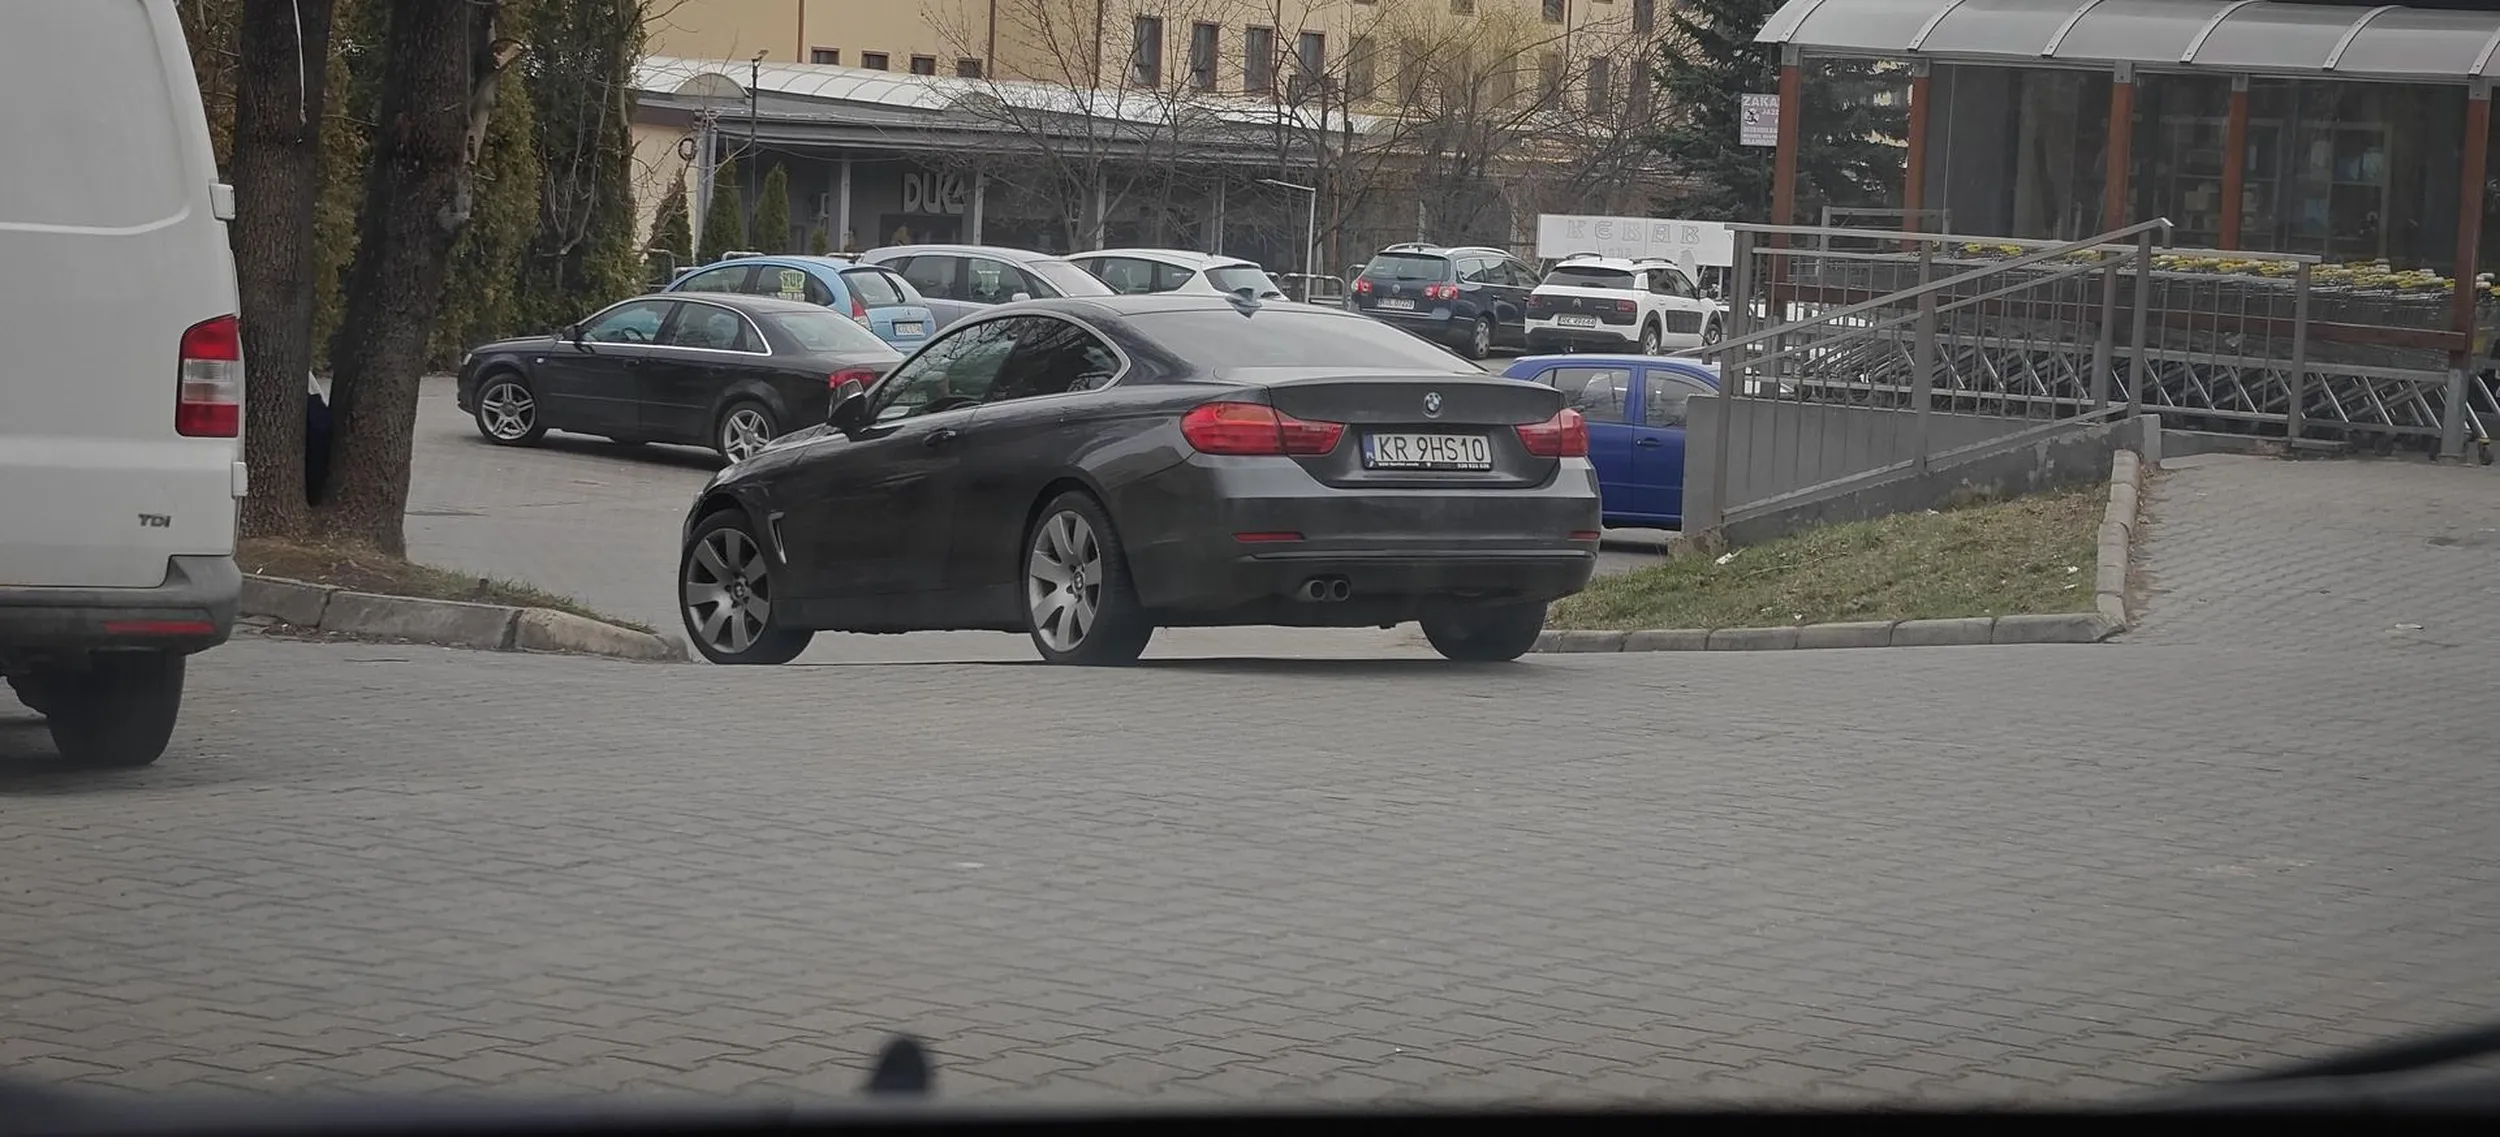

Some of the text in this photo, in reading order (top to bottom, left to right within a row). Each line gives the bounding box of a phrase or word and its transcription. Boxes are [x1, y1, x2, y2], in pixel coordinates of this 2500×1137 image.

[1743, 96, 1779, 107] ZAKA
[1566, 219, 1700, 245] KEBAB
[1378, 436, 1485, 462] KR 9HS10
[138, 513, 171, 528] TDI
